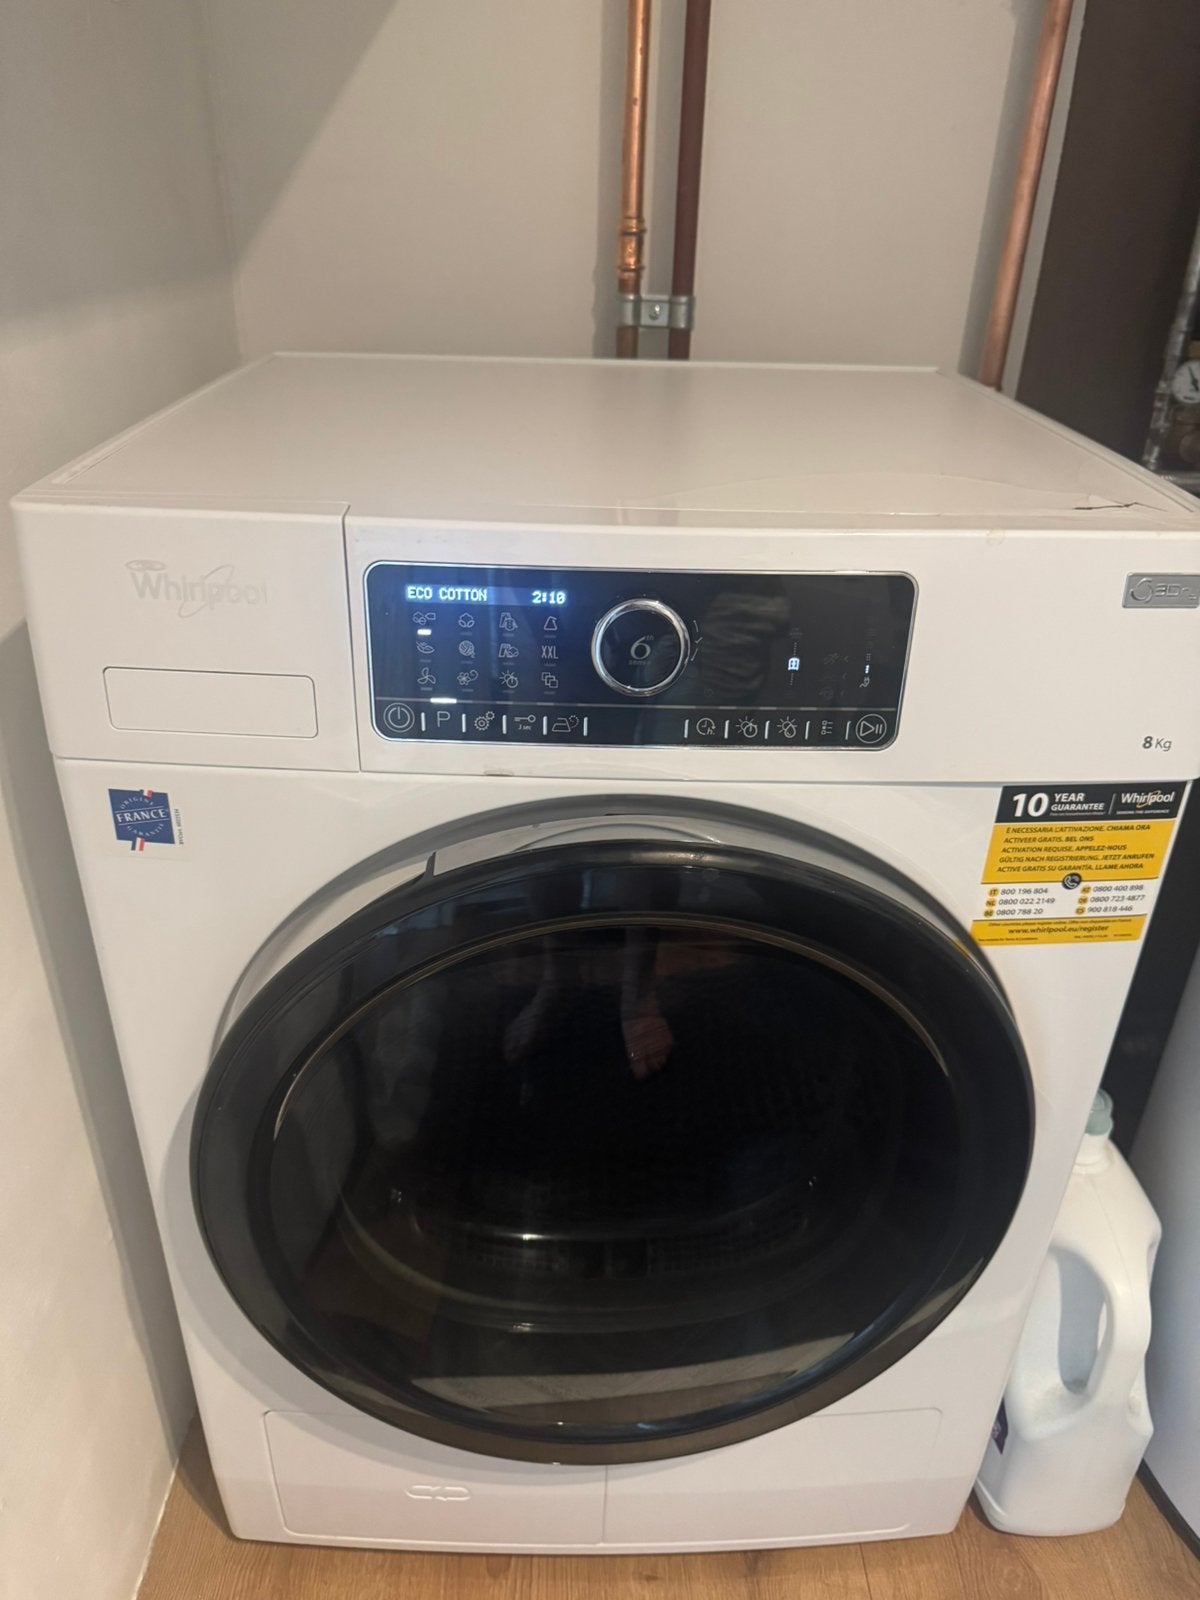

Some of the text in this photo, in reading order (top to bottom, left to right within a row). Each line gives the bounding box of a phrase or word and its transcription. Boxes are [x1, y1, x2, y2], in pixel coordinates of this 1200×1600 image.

[129, 569, 269, 612] Whirlpool
[407, 586, 567, 605] ECO COTTON 2:10
[541, 645, 559, 659] XXL
[437, 711, 451, 728] P
[1142, 735, 1172, 752] 8 Kg
[1012, 792, 1049, 817] 10
[1053, 792, 1085, 802] YEAR
[1120, 791, 1175, 808] Whirlpool
[1050, 802, 1105, 811] GUARANTEE
[116, 808, 167, 823] FRANCE
[999, 855, 1024, 863] GÜLTIG
[1008, 925, 1109, 934] www.whirlpool.eu/register
